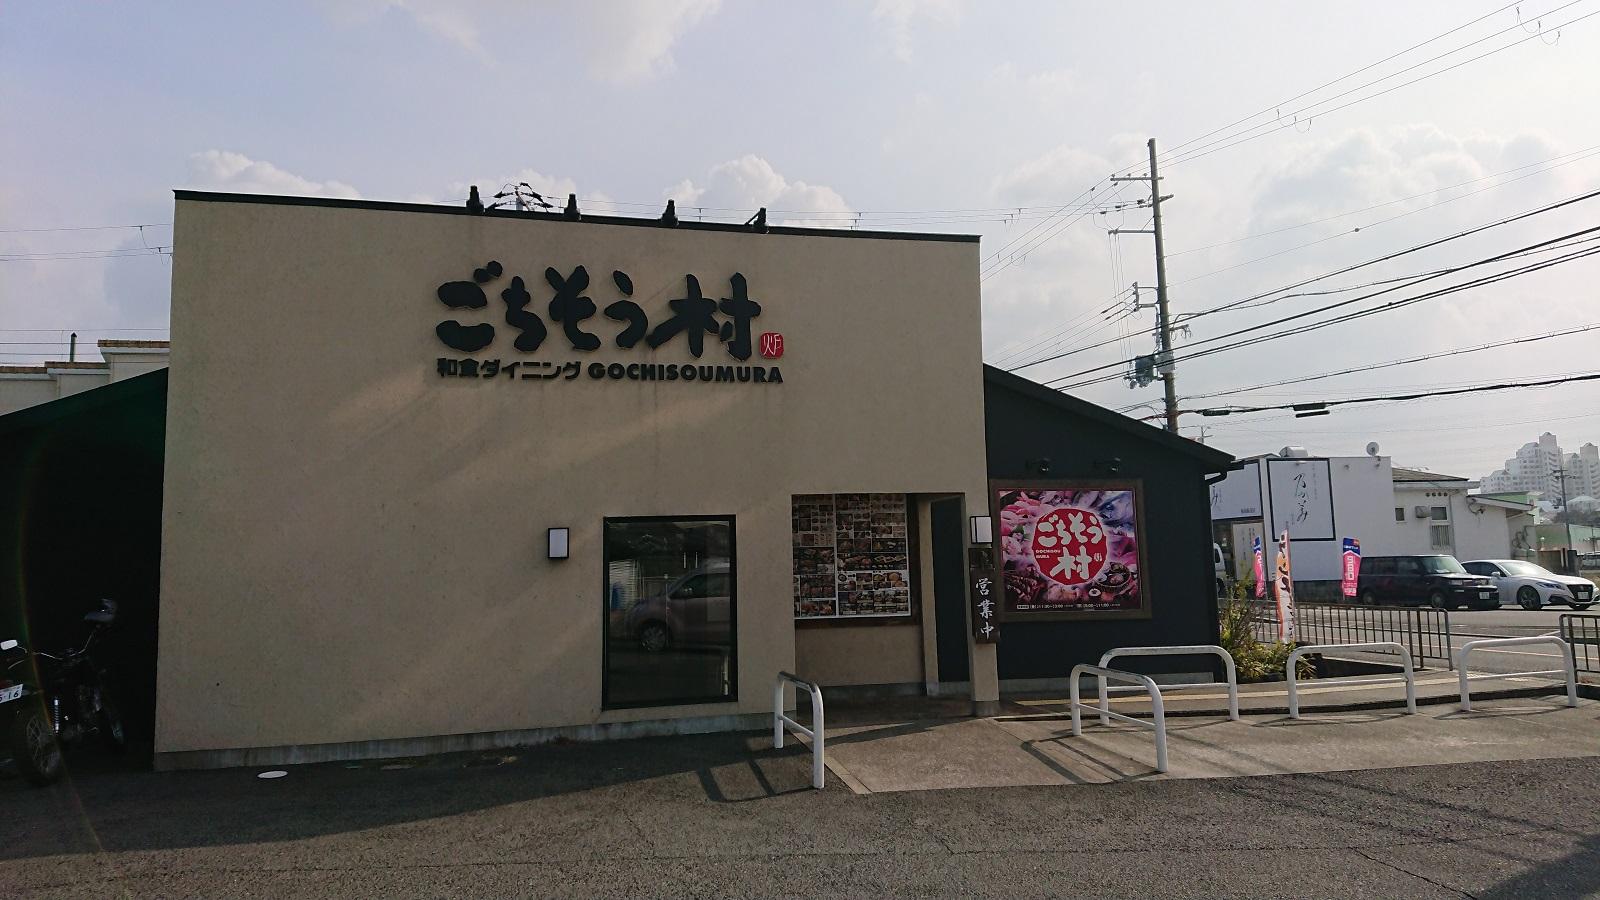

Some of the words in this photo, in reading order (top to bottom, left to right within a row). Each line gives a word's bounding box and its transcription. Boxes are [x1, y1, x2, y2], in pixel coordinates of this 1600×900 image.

[436, 260, 762, 361] ごちそう村
[587, 362, 784, 383] GOCHISOUMURA
[1038, 512, 1103, 547] ごちそう
[1049, 545, 1093, 580] 村
[975, 577, 995, 640] 営業中
